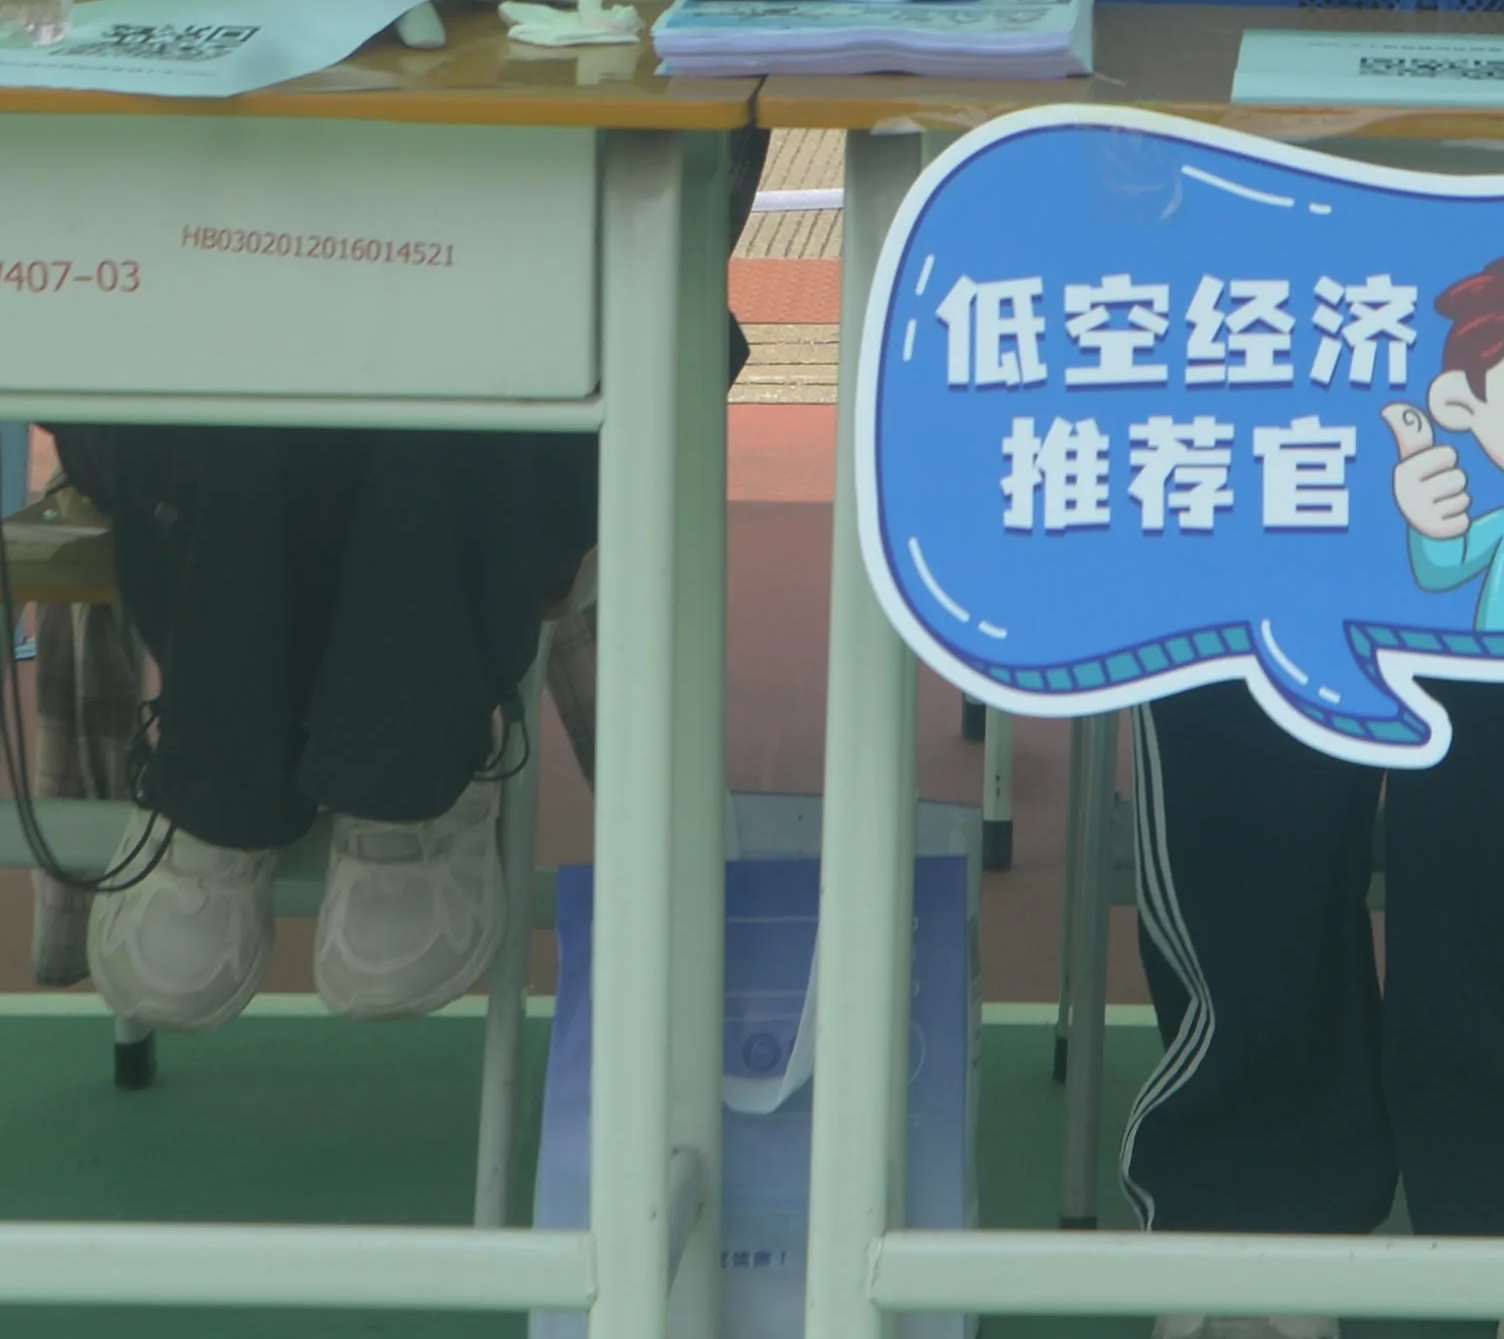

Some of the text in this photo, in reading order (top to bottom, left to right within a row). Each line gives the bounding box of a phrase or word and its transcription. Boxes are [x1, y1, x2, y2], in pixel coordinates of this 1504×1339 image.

[181, 225, 456, 268] HB0302012016014521
[936, 273, 1419, 388] 低空经济
[1000, 414, 1359, 531] 推荐官
